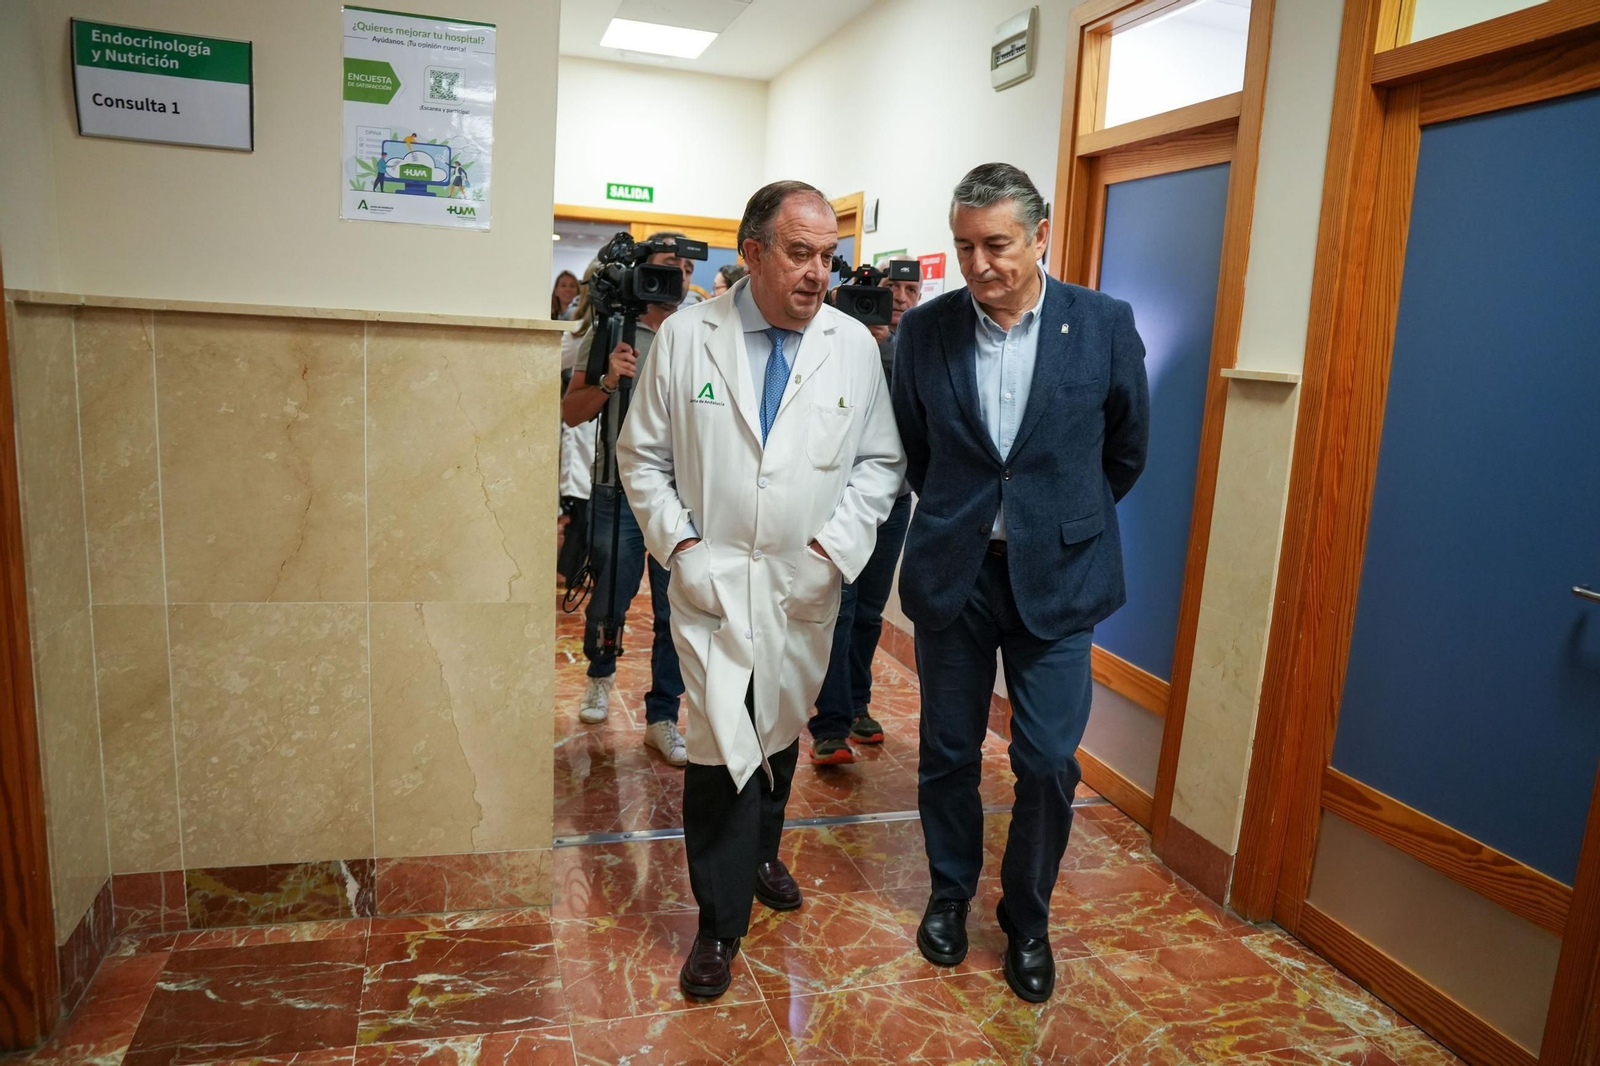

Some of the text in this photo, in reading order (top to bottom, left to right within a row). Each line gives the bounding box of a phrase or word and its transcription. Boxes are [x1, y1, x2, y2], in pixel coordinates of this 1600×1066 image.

[91, 29, 211, 57] Endocrinología
[352, 21, 485, 45] ¿Quieres mejorar tu hospital?
[372, 36, 405, 46] Ayúdanos.
[417, 41, 442, 50] opinión
[91, 48, 179, 69] y Nutrición
[347, 73, 393, 85] ENCUESTA
[92, 93, 181, 115] Consulta 1
[610, 185, 650, 200] SALIDA
